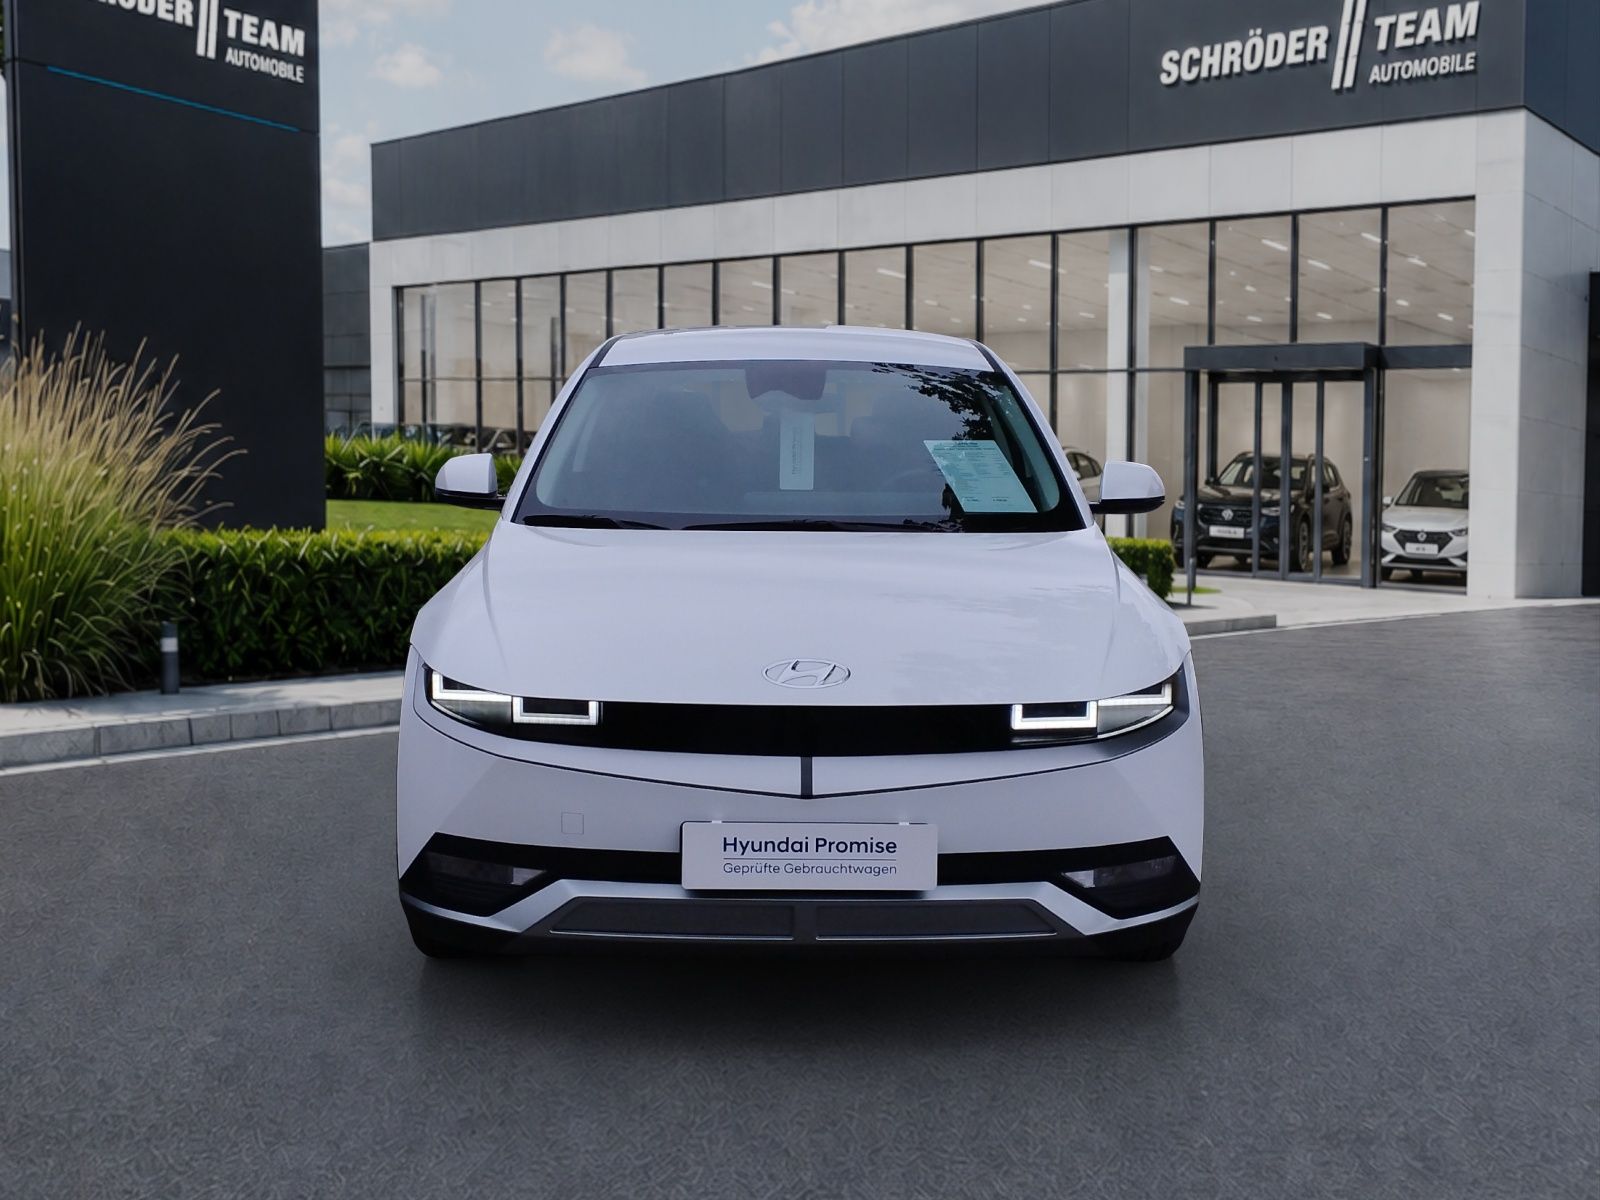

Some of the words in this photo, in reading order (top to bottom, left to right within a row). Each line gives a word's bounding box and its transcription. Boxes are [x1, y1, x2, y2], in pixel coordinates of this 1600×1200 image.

[223, 8, 306, 57] TEAM
[1160, 25, 1329, 85] SCHRÖDER
[1374, 0, 1481, 52] TEAM
[225, 47, 305, 84] AUTOMOBILE
[1368, 51, 1477, 84] AUTOMOBILE
[723, 836, 809, 857] Hyundai
[815, 836, 898, 854] Promise
[723, 862, 781, 877] Geprüfte
[783, 862, 898, 877] Gebrauchtwagen
